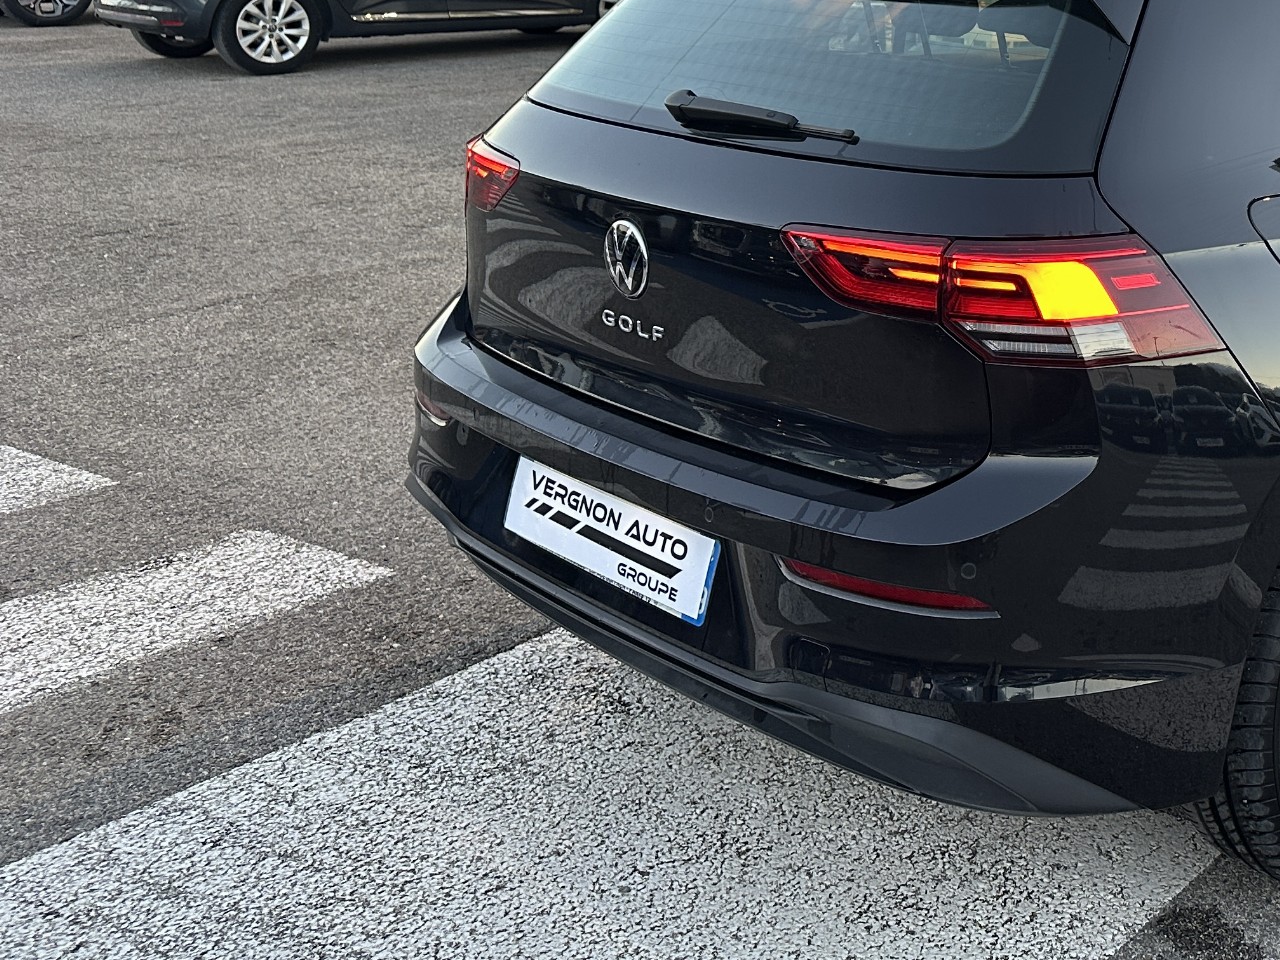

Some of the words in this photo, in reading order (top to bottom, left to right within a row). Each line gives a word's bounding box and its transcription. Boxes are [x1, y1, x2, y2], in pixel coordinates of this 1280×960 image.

[601, 309, 665, 342] GOLF
[531, 469, 623, 532] VERGNON
[624, 519, 688, 561] AUTO
[617, 562, 679, 603] GROUPE
